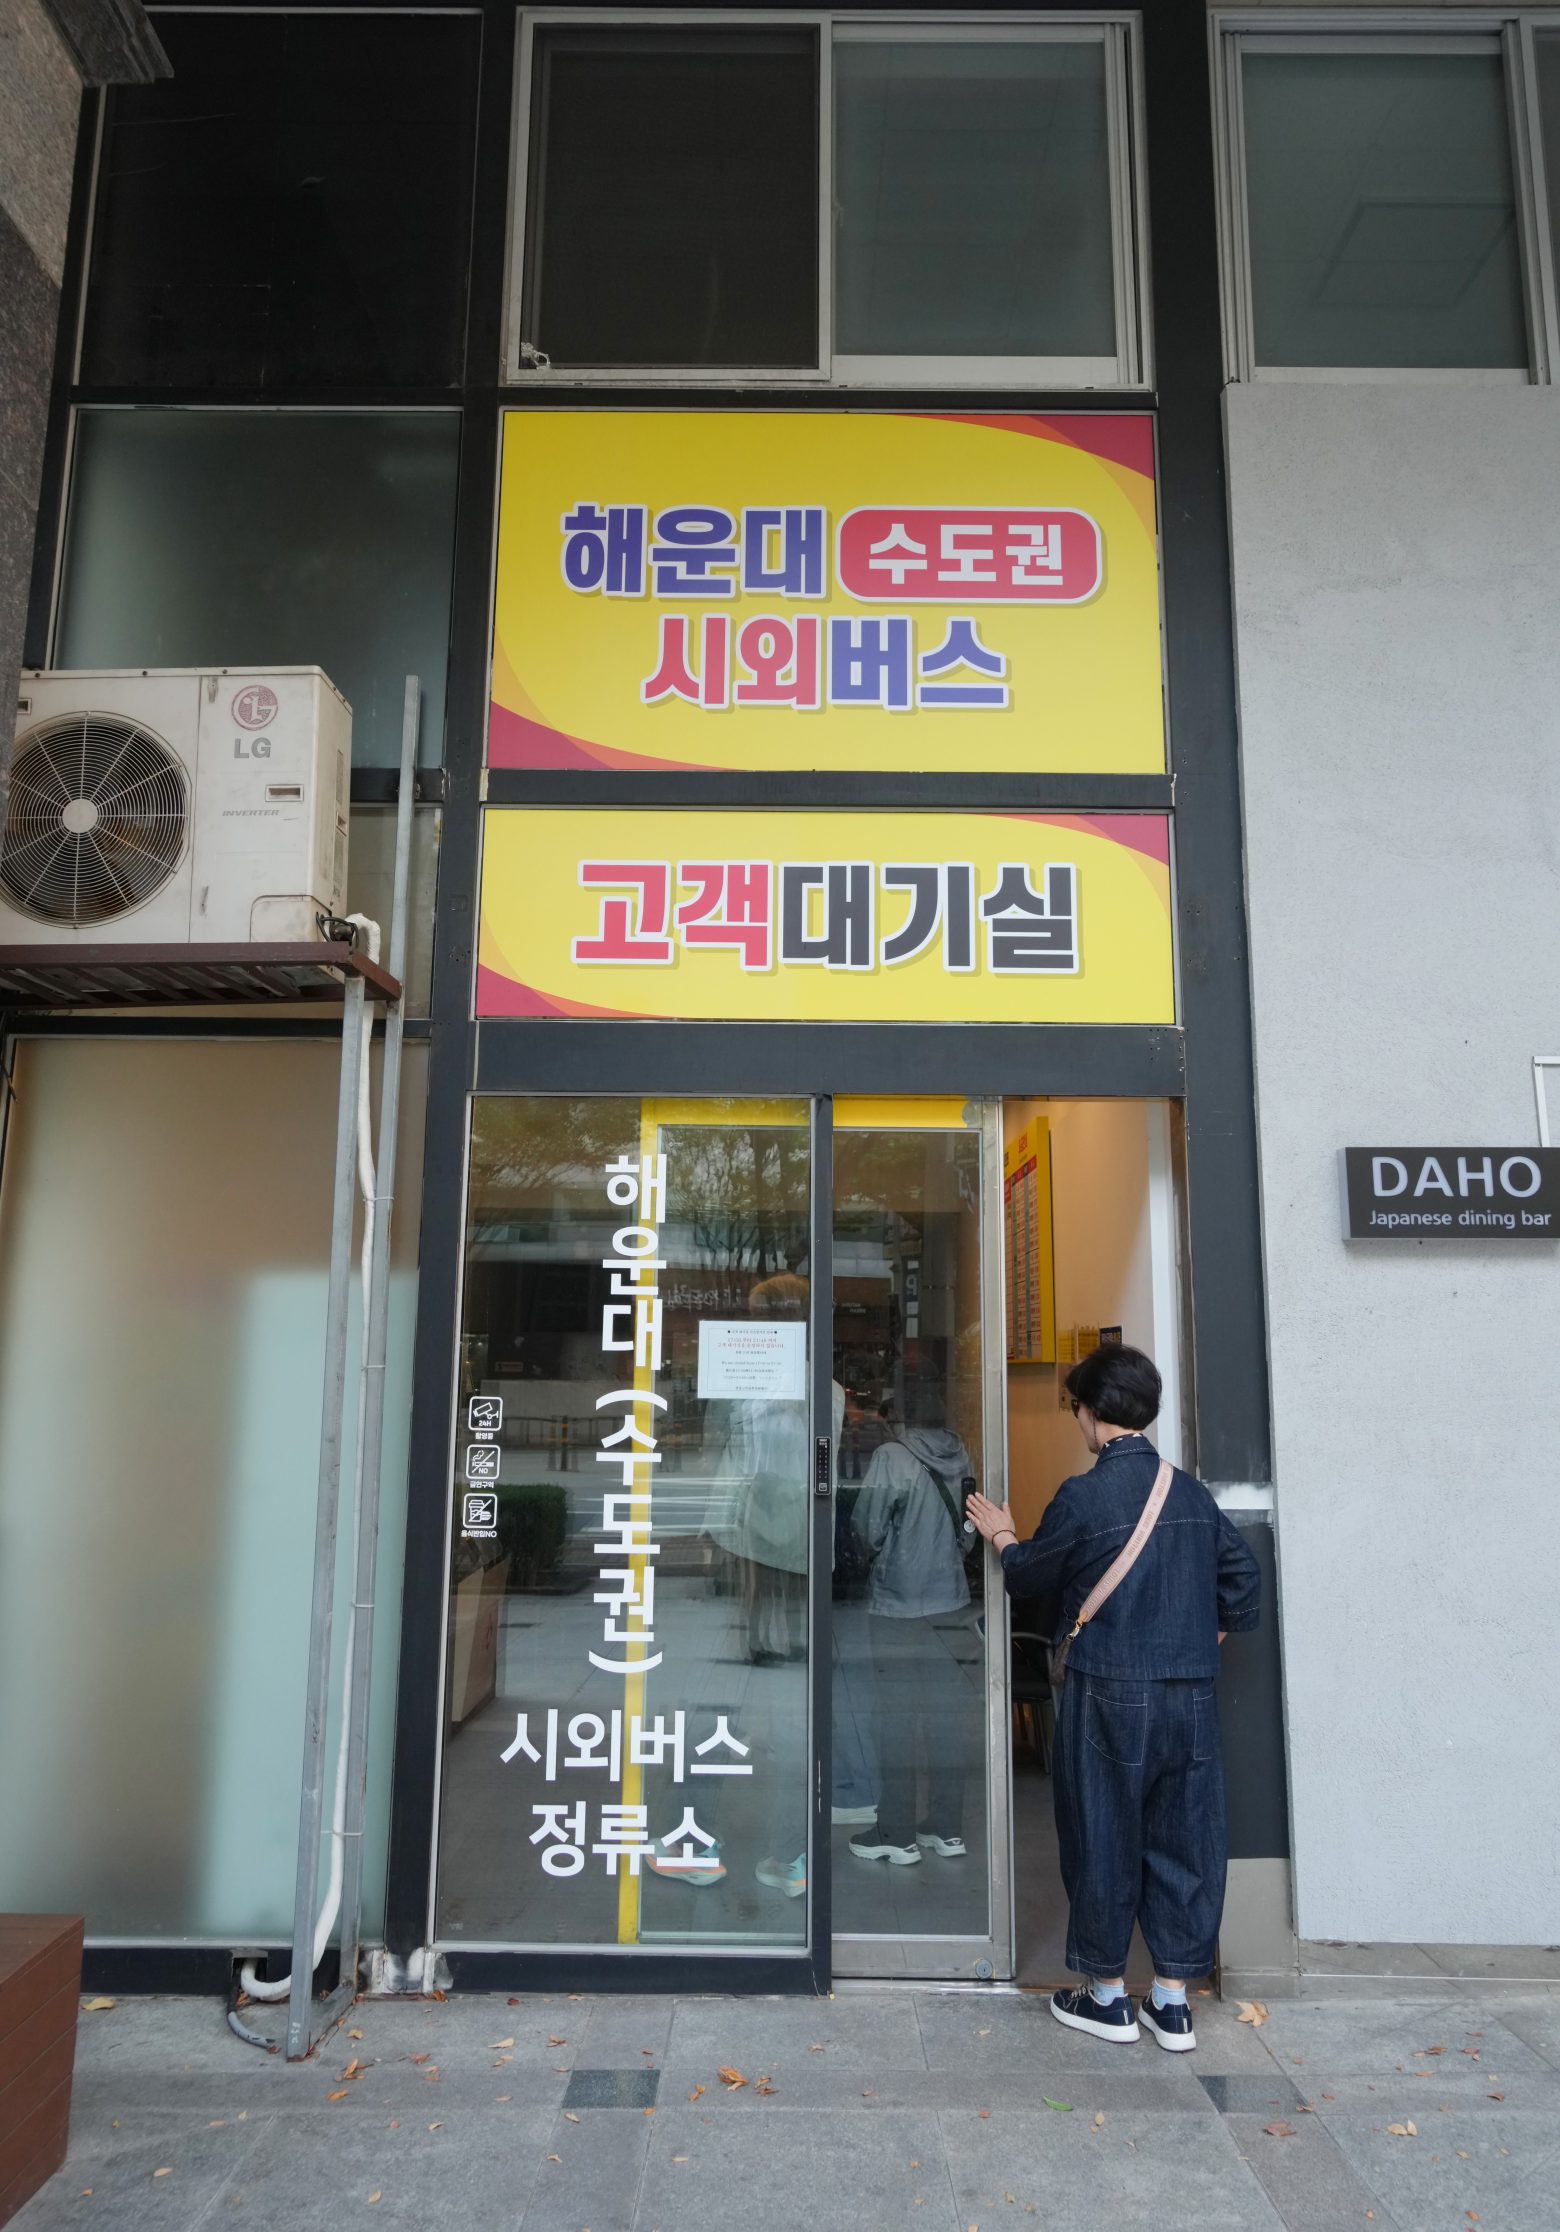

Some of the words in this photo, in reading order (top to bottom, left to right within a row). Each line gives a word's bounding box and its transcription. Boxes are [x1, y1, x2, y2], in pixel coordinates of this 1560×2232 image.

[561, 502, 826, 598] 해운대
[868, 522, 1064, 587] 수도권
[641, 613, 1007, 710] 시외버스
[233, 736, 272, 759] LG
[222, 809, 280, 817] INVERTER
[572, 860, 1078, 972] 고객대기실
[1371, 1155, 1542, 1198] DAHO
[1369, 1210, 1452, 1229] Japanese
[1458, 1209, 1516, 1229] dining
[1521, 1209, 1552, 1226] bar
[478, 1419, 492, 1427] 24H
[470, 1480, 494, 1488] 금연구역
[500, 1709, 753, 1783] 시외버스
[528, 1801, 720, 1877] 정류소
